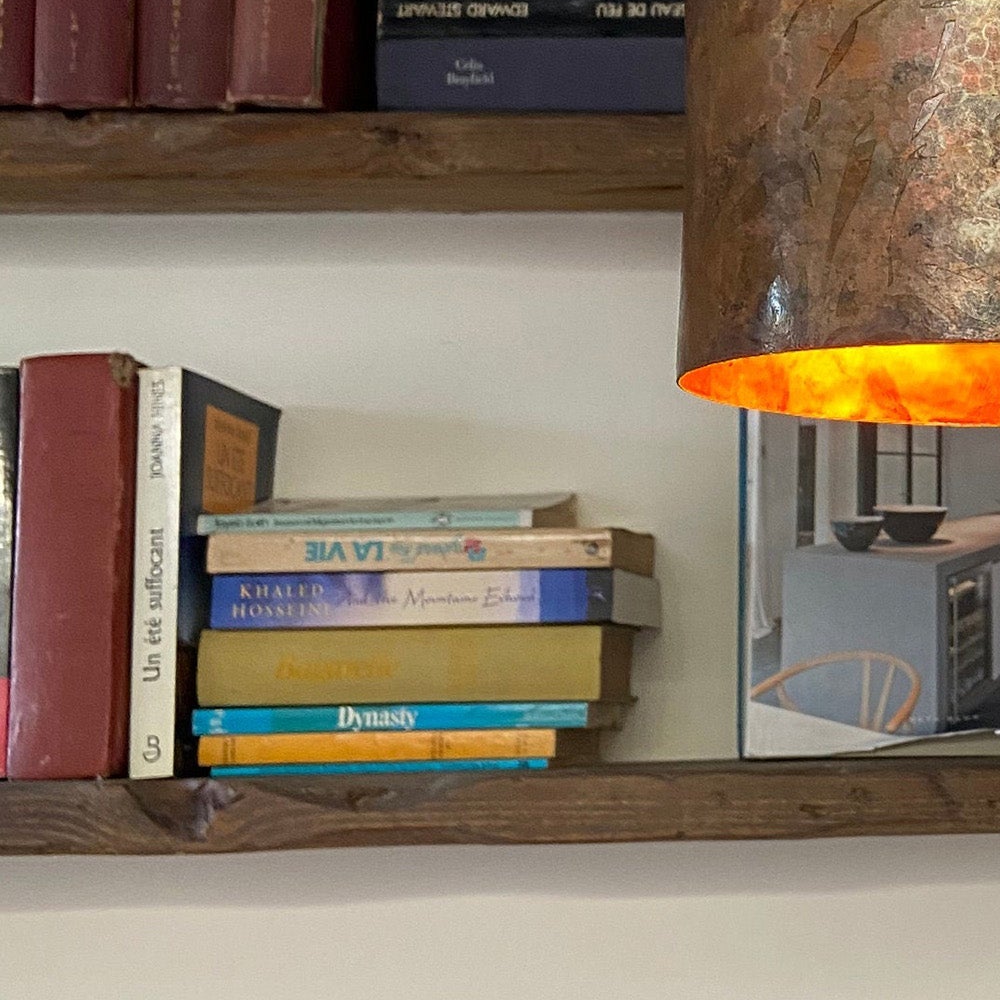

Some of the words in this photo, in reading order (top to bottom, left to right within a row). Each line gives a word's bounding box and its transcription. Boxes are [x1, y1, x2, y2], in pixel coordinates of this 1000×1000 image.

[396, 2, 463, 18] STEWART
[466, 2, 529, 18] EDWARD
[595, 2, 624, 18] FEU
[627, 2, 647, 18] DE
[305, 541, 346, 563] VIE
[353, 541, 384, 563] LA
[145, 528, 164, 611] suffocant
[240, 583, 325, 599] KHALED
[232, 602, 330, 618] HOSSEINI
[144, 617, 162, 646] été
[143, 653, 161, 682] Un
[337, 706, 419, 732] Dynasty
